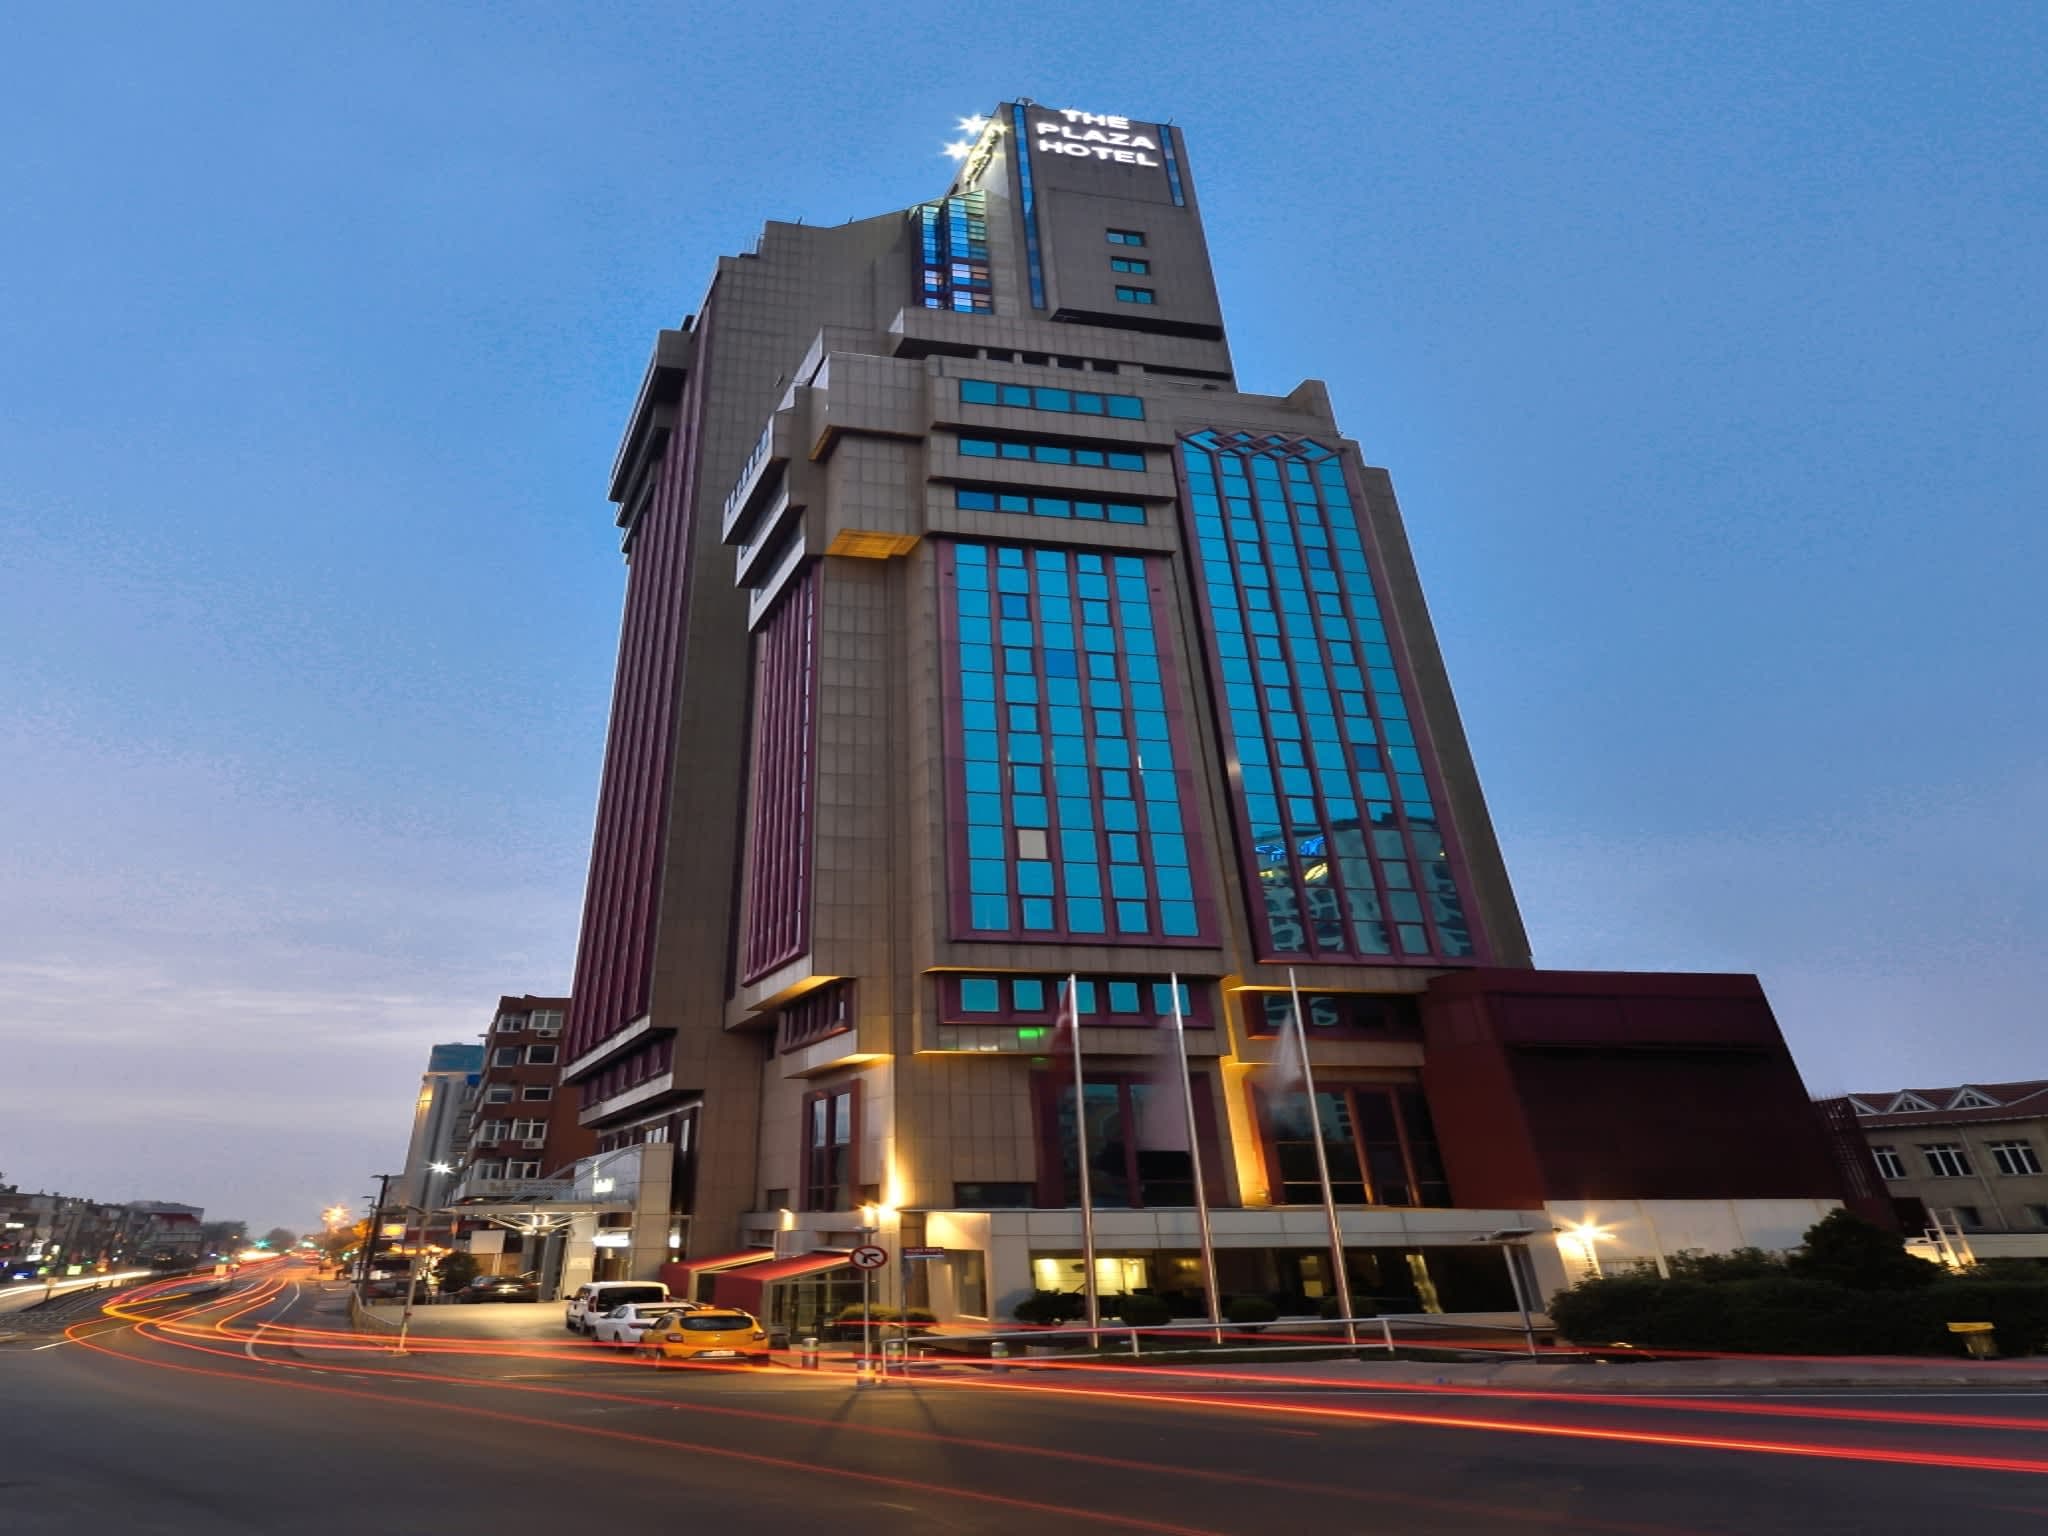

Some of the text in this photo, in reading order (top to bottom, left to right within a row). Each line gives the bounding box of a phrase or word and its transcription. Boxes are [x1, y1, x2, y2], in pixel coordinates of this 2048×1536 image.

[1060, 109, 1130, 130] THE
[1036, 122, 1157, 150] PLAZA
[1038, 139, 1158, 167] HOTEL
